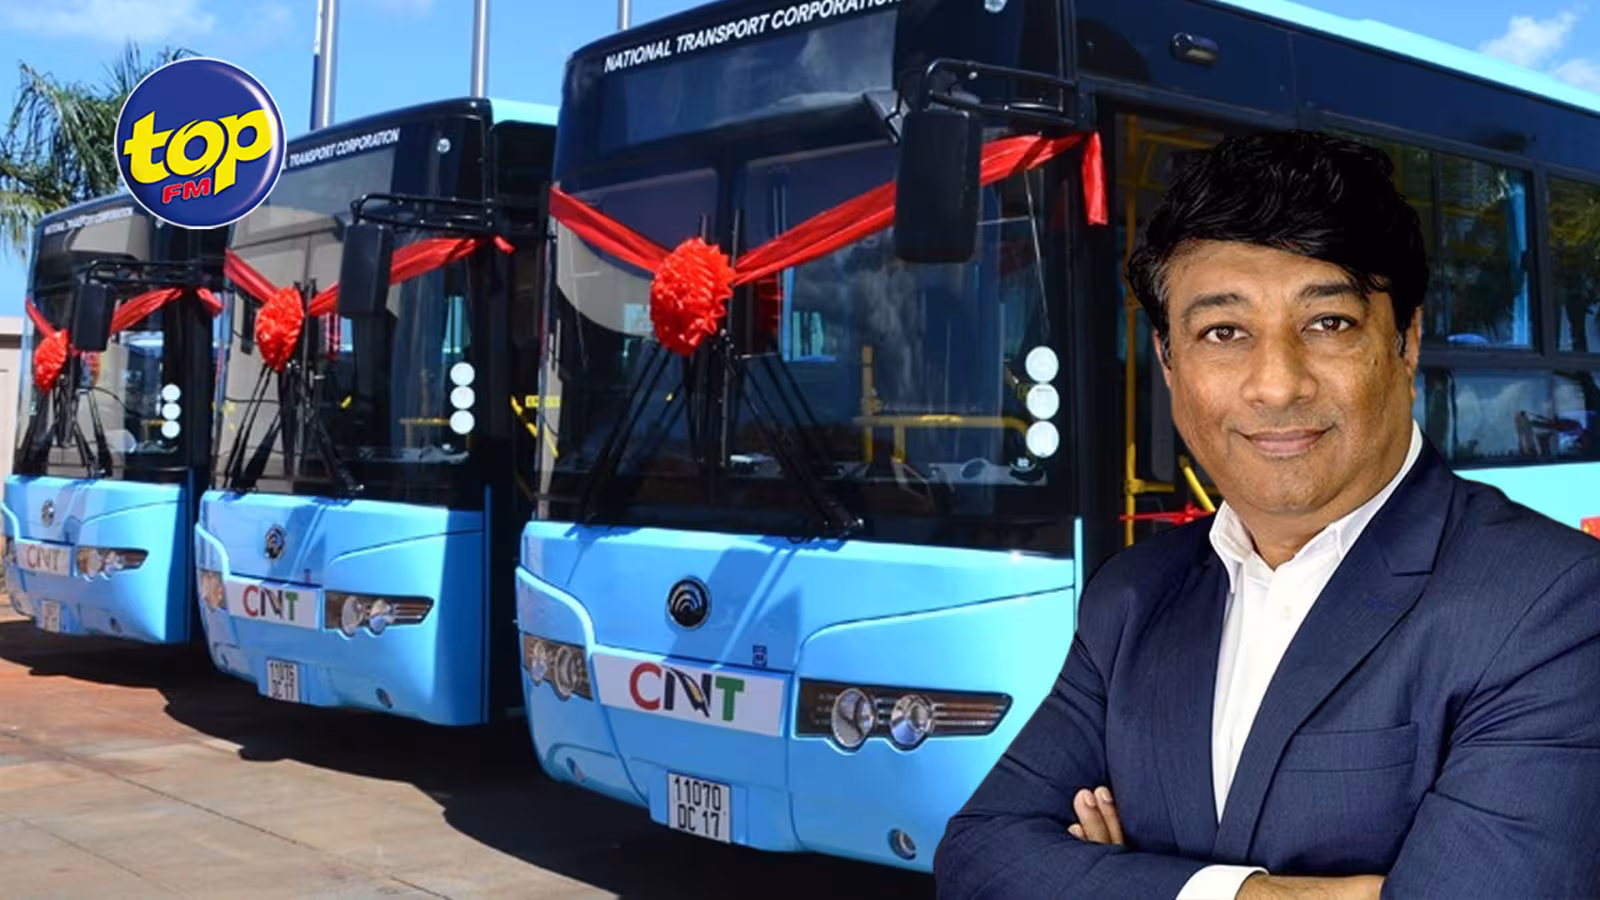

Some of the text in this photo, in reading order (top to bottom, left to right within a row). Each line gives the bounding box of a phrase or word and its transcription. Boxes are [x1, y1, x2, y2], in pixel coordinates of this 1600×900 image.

[604, 40, 671, 72] NATIONAL
[676, 15, 768, 53] TRANSPORT
[290, 143, 336, 167] TRANSPORT
[336, 128, 400, 156] CORPORATION
[243, 585, 298, 621] CNT
[629, 662, 744, 721] CNT
[674, 776, 721, 811] 11070
[677, 804, 719, 837] DC 17
